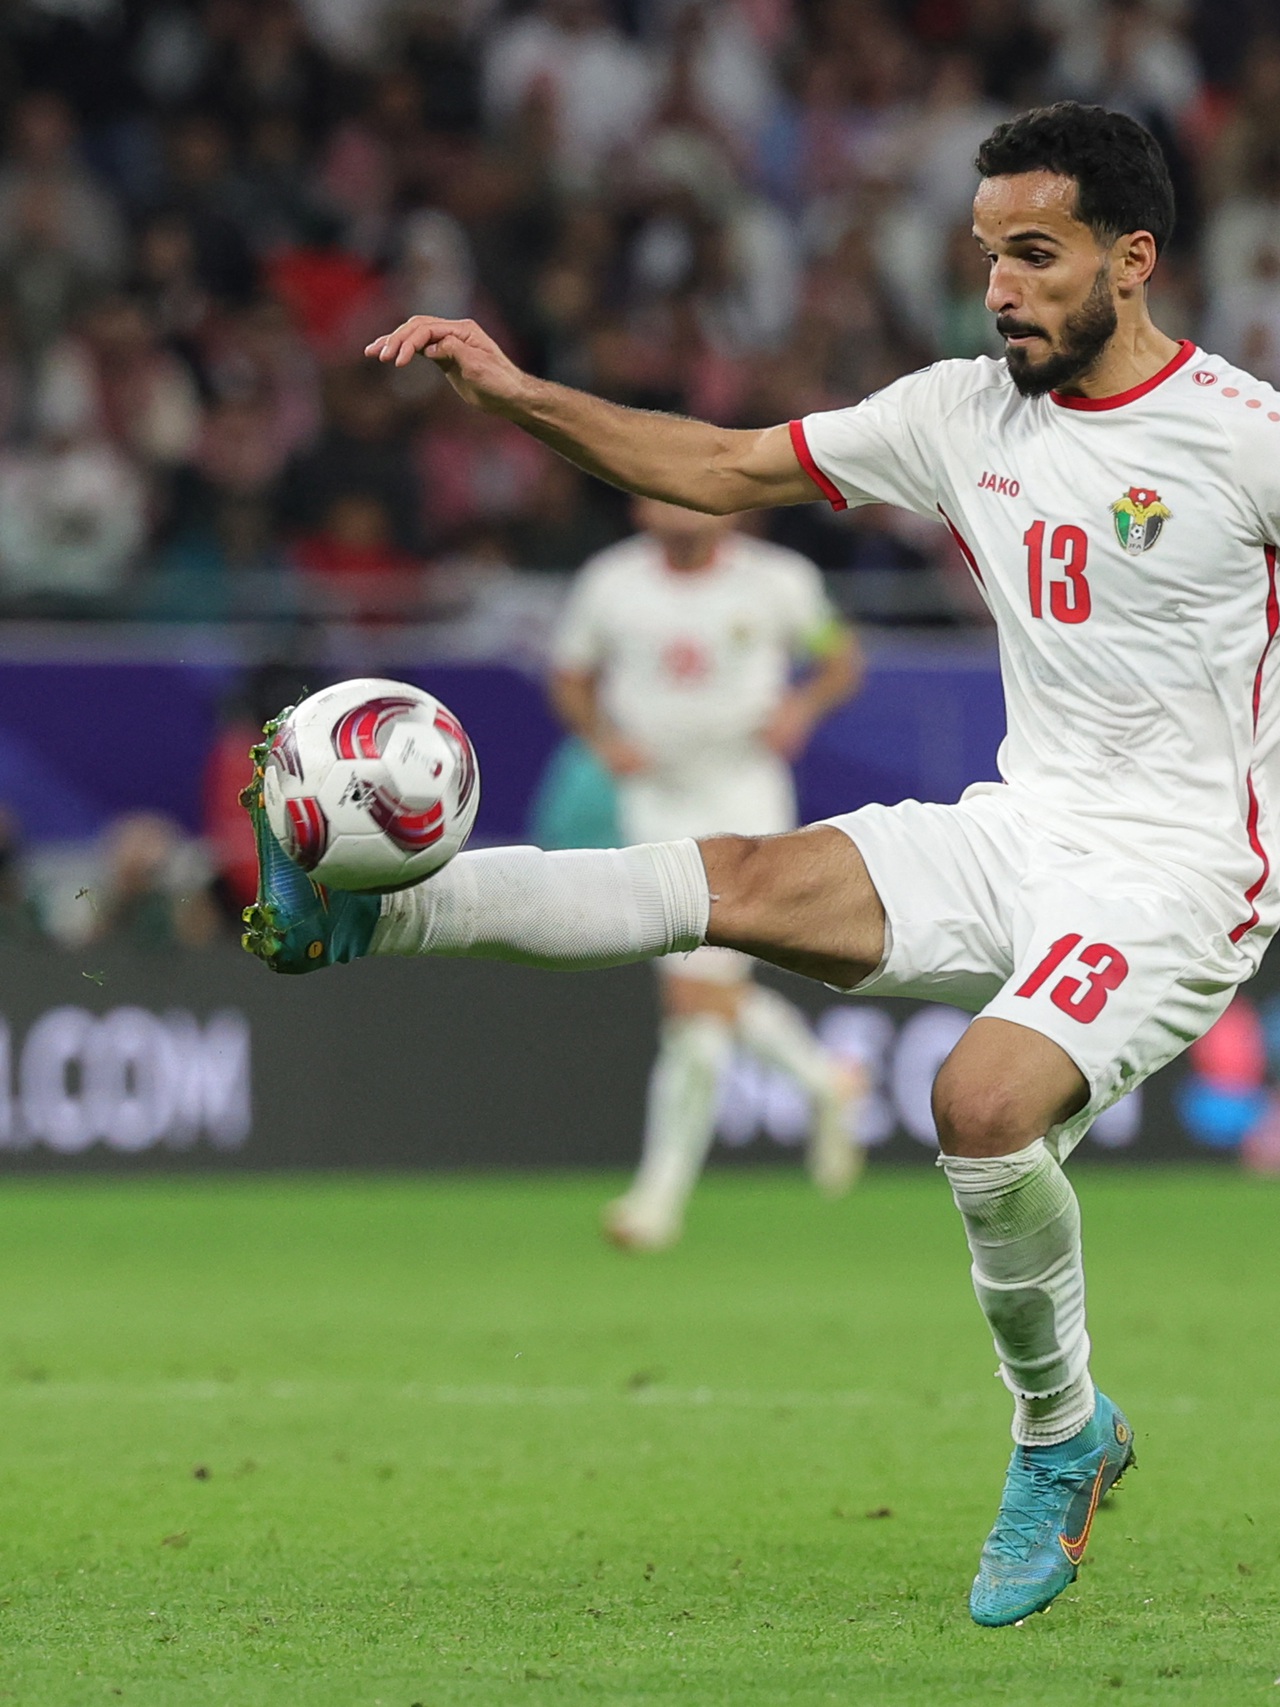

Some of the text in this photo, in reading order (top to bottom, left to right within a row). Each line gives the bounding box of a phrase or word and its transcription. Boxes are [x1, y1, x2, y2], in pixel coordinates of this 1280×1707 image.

[977, 471, 1021, 498] JAKO
[1023, 519, 1092, 625] 13
[1013, 932, 1129, 1025] 13
